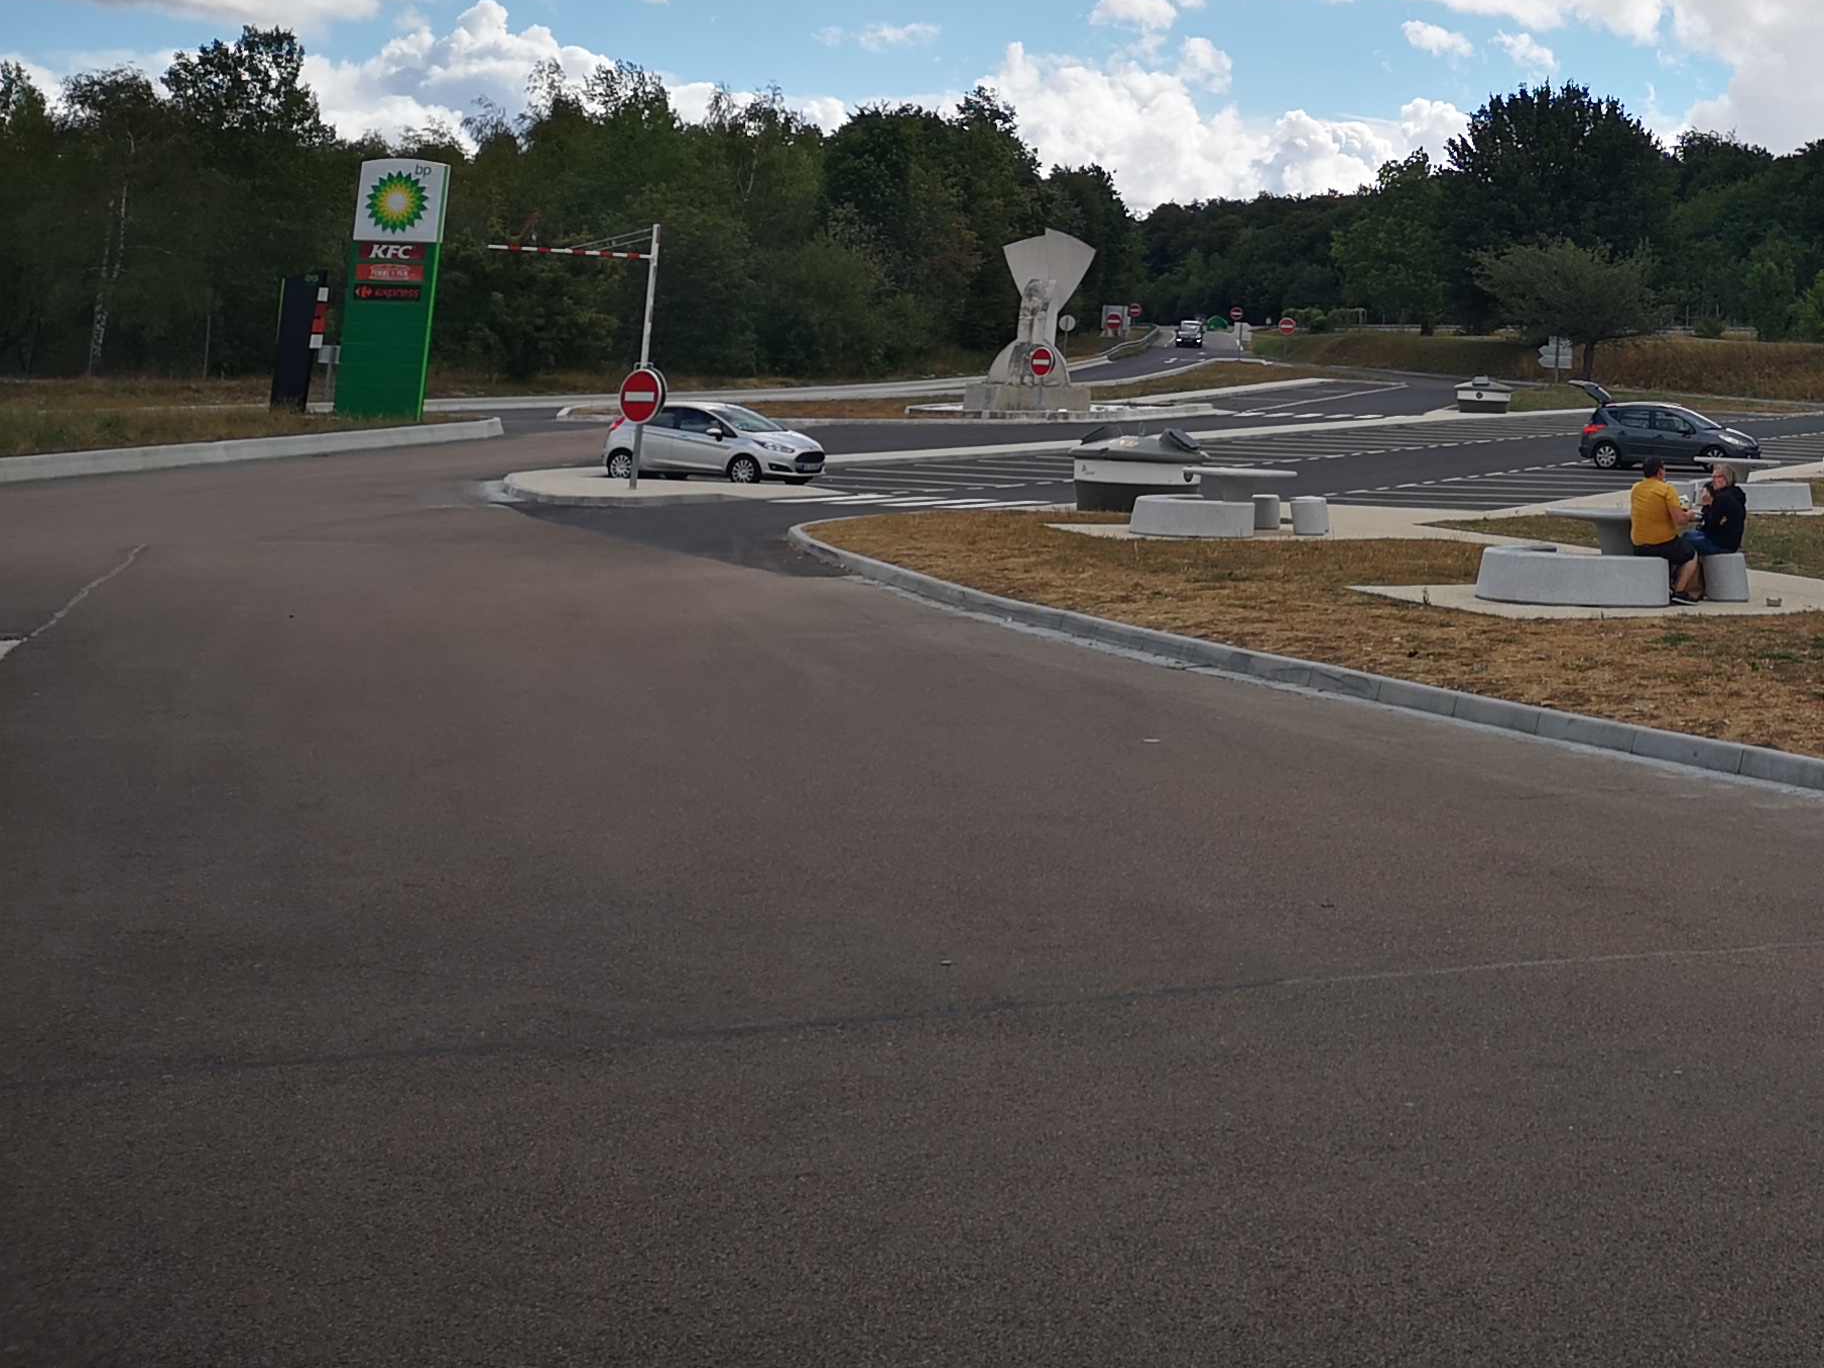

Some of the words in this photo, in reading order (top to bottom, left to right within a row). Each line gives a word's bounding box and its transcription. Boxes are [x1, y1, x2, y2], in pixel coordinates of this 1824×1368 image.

[415, 163, 432, 178] bp
[368, 244, 413, 259] KFC
[375, 288, 420, 299] express
